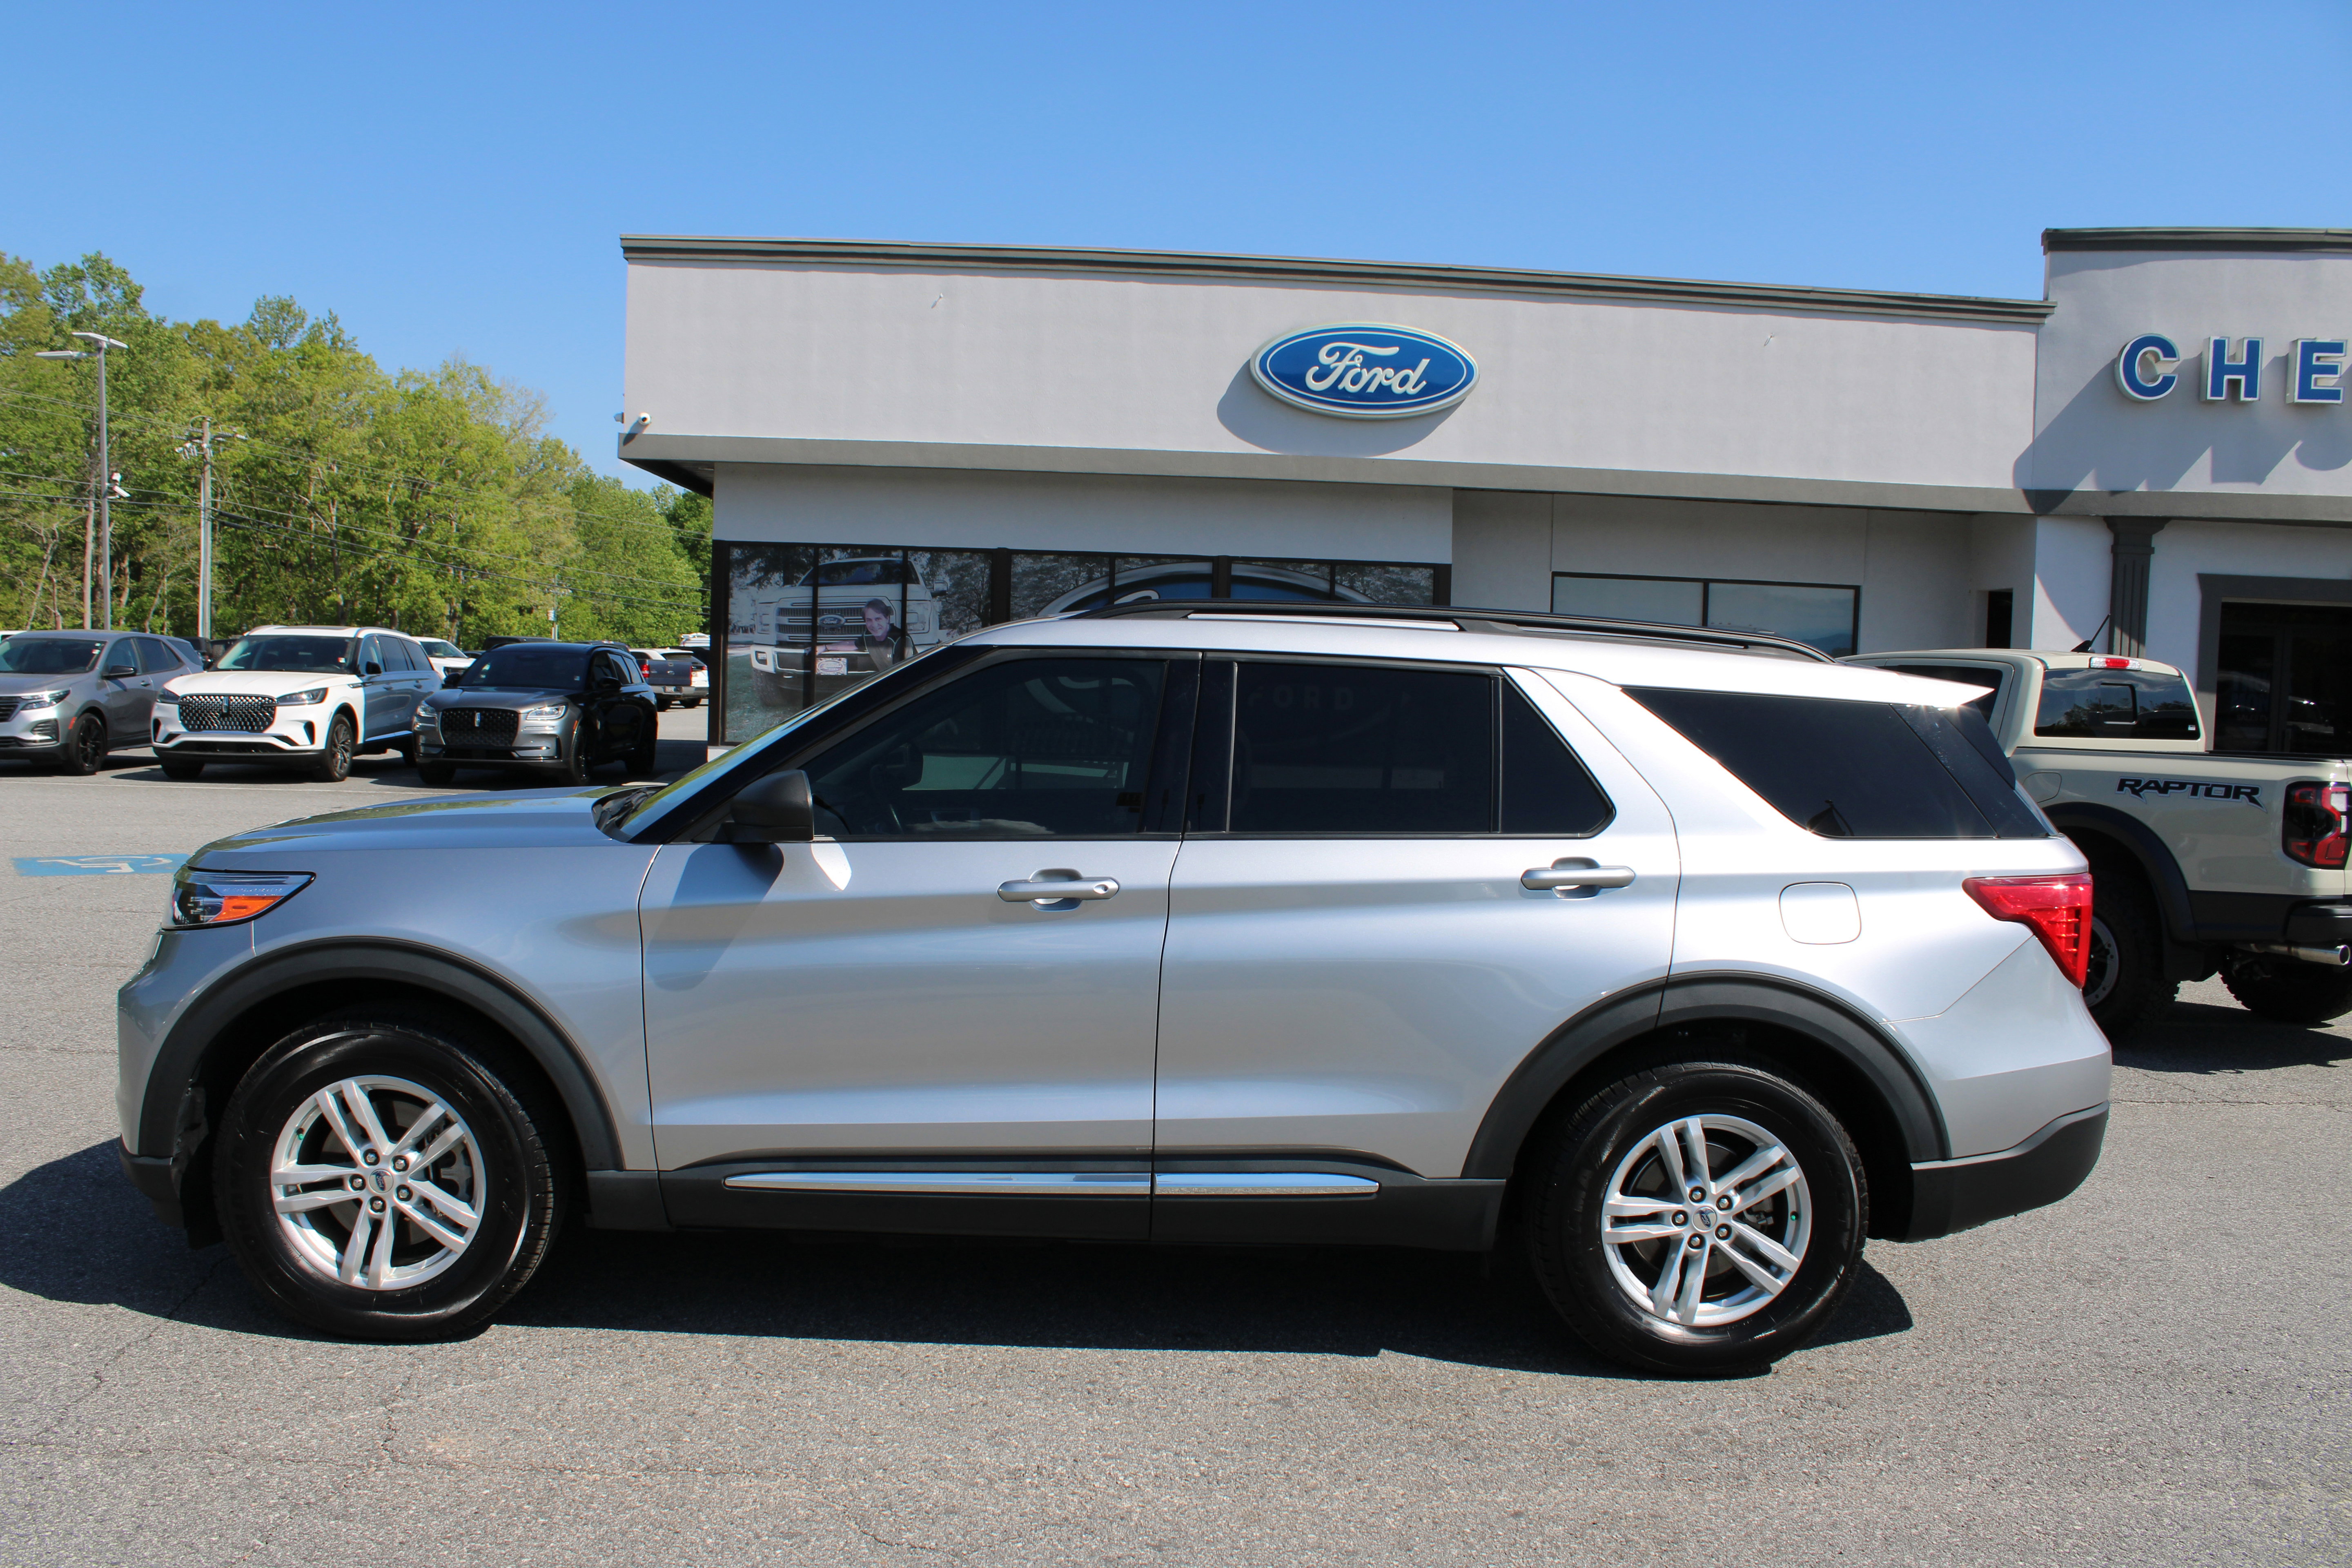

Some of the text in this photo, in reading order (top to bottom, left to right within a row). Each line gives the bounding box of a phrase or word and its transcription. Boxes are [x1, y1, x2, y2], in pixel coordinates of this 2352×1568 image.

[1305, 342, 1430, 394] Ford
[2115, 333, 2348, 403] CHE
[2115, 777, 2267, 813] RAPTOR
